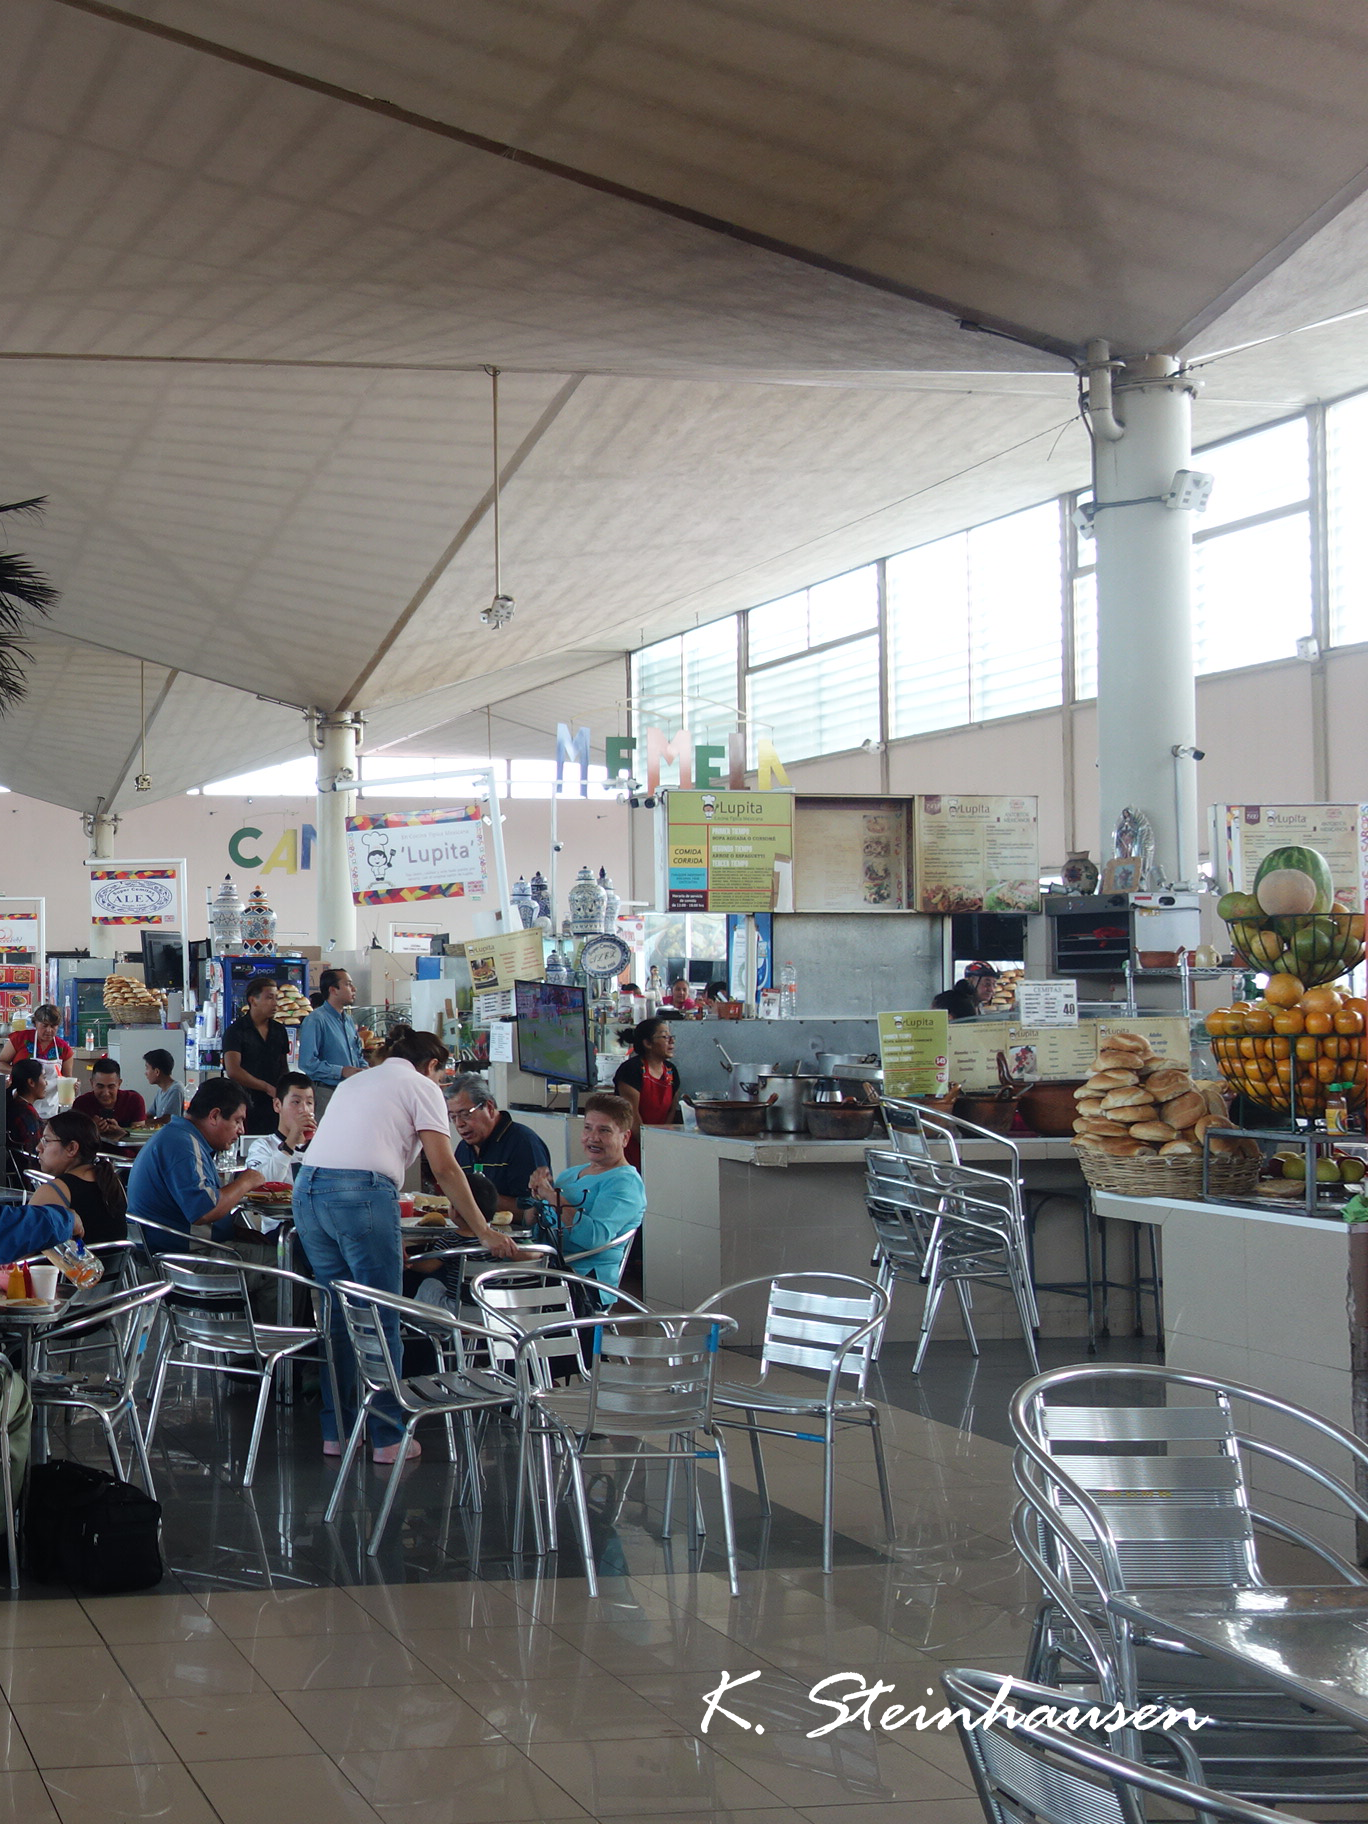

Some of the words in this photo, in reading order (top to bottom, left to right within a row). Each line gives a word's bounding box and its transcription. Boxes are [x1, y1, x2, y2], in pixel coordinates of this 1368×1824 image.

[720, 801, 763, 817] Lupita
[960, 804, 990, 815] Lupita
[1277, 814, 1307, 825] Lupita
[113, 895, 155, 903] ALEX
[475, 944, 495, 954] Lupita
[1063, 1003, 1075, 1014] 40
[905, 1018, 934, 1027] Lupita
[1018, 1029, 1039, 1037] Lupita
